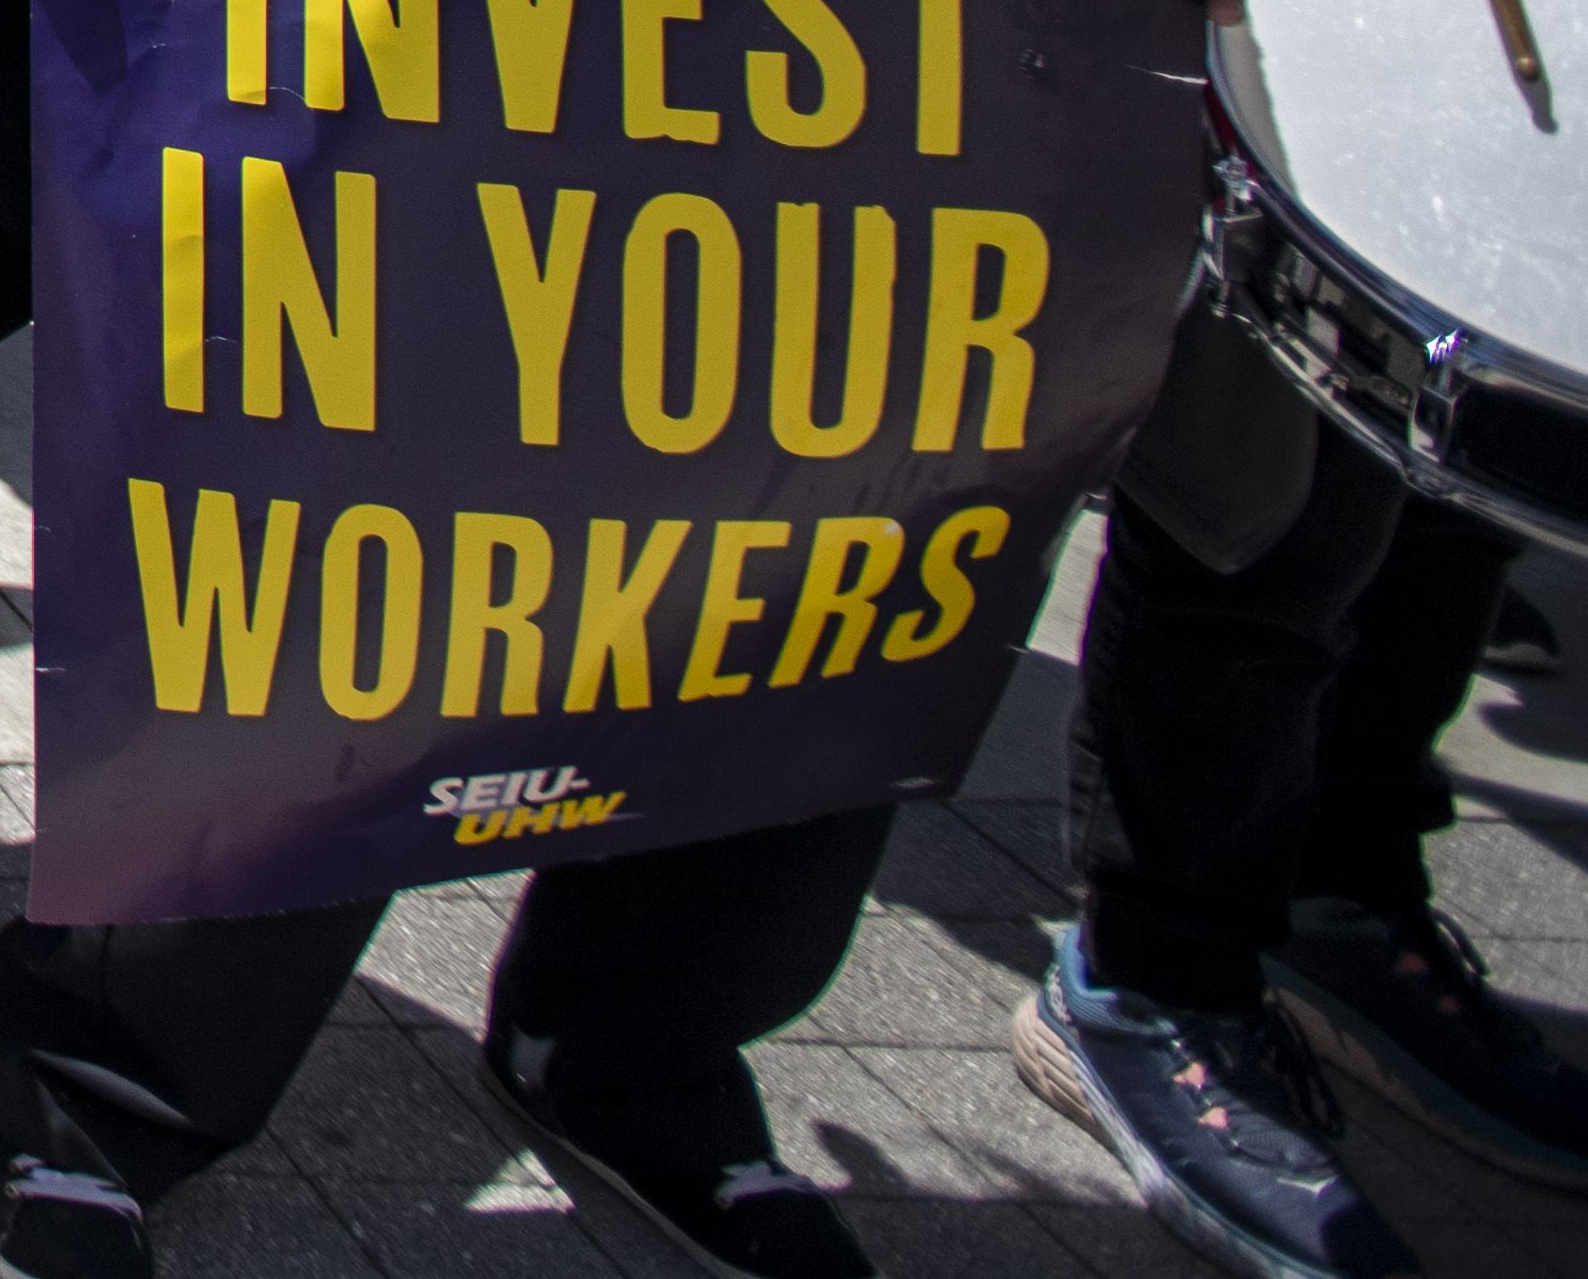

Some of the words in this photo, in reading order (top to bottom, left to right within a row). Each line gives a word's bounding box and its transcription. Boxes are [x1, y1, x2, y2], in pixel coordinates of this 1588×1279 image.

[162, 146, 376, 431] IN
[477, 182, 1049, 458] YOUR
[128, 478, 1009, 720] WORKERS
[423, 766, 590, 816] SEIU-
[453, 792, 627, 845] UHW
